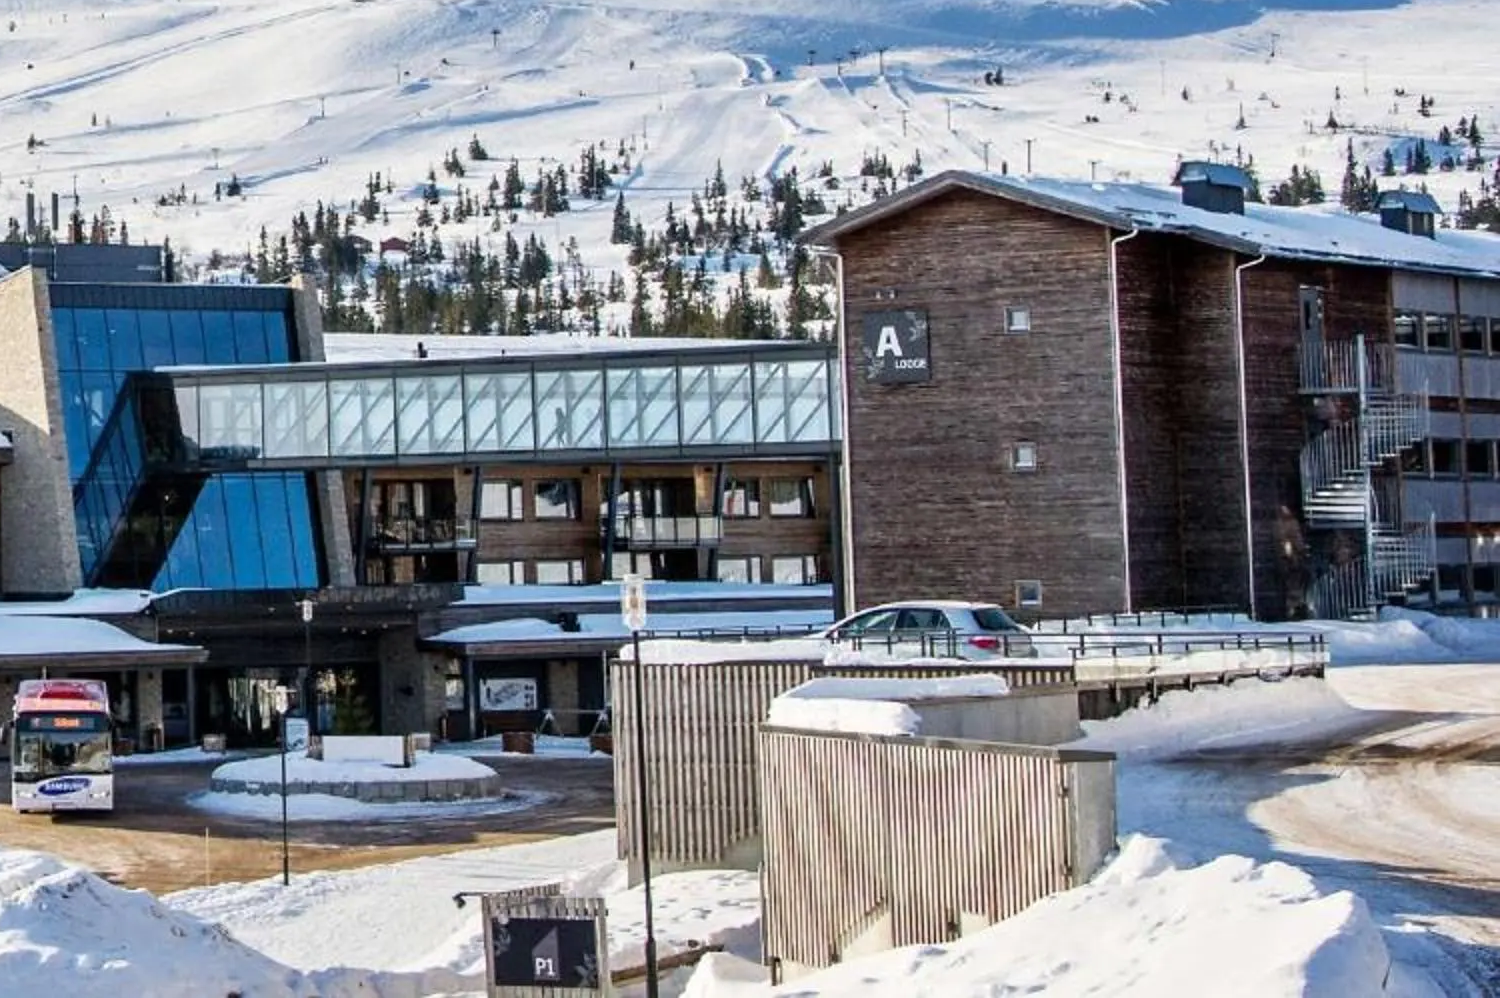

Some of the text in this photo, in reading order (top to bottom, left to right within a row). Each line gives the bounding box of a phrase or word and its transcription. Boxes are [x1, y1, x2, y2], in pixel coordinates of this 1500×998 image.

[876, 326, 903, 357] A
[895, 358, 927, 369] LODGE
[535, 957, 555, 976] P1
